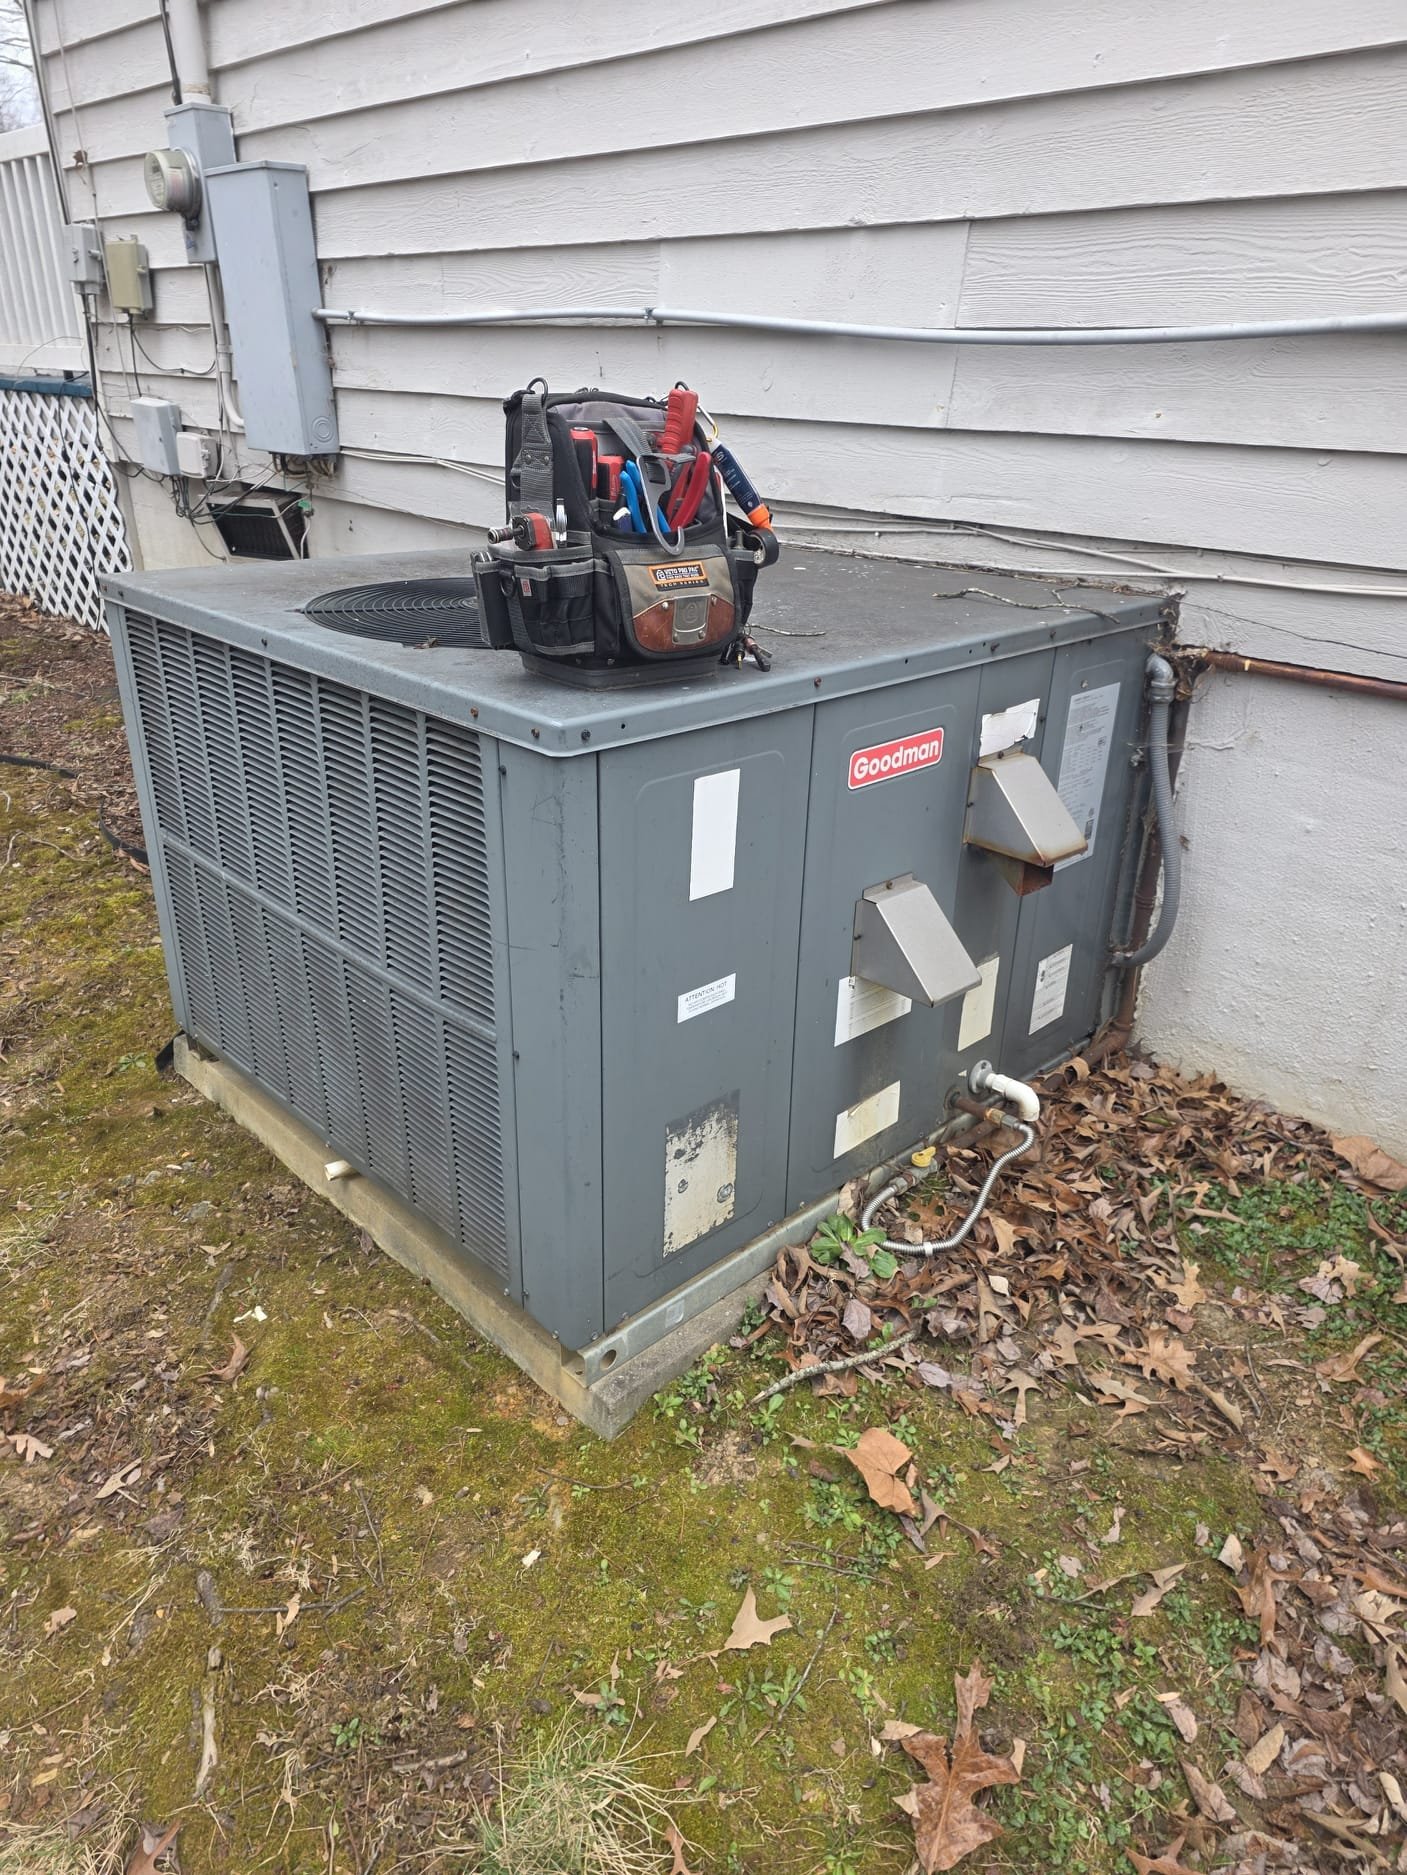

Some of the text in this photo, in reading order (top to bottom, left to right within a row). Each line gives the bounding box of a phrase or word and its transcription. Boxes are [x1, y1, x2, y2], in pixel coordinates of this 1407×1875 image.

[853, 740, 940, 780] Goodman
[685, 987, 715, 1001] ATTENTION
[716, 981, 727, 989] HOT
